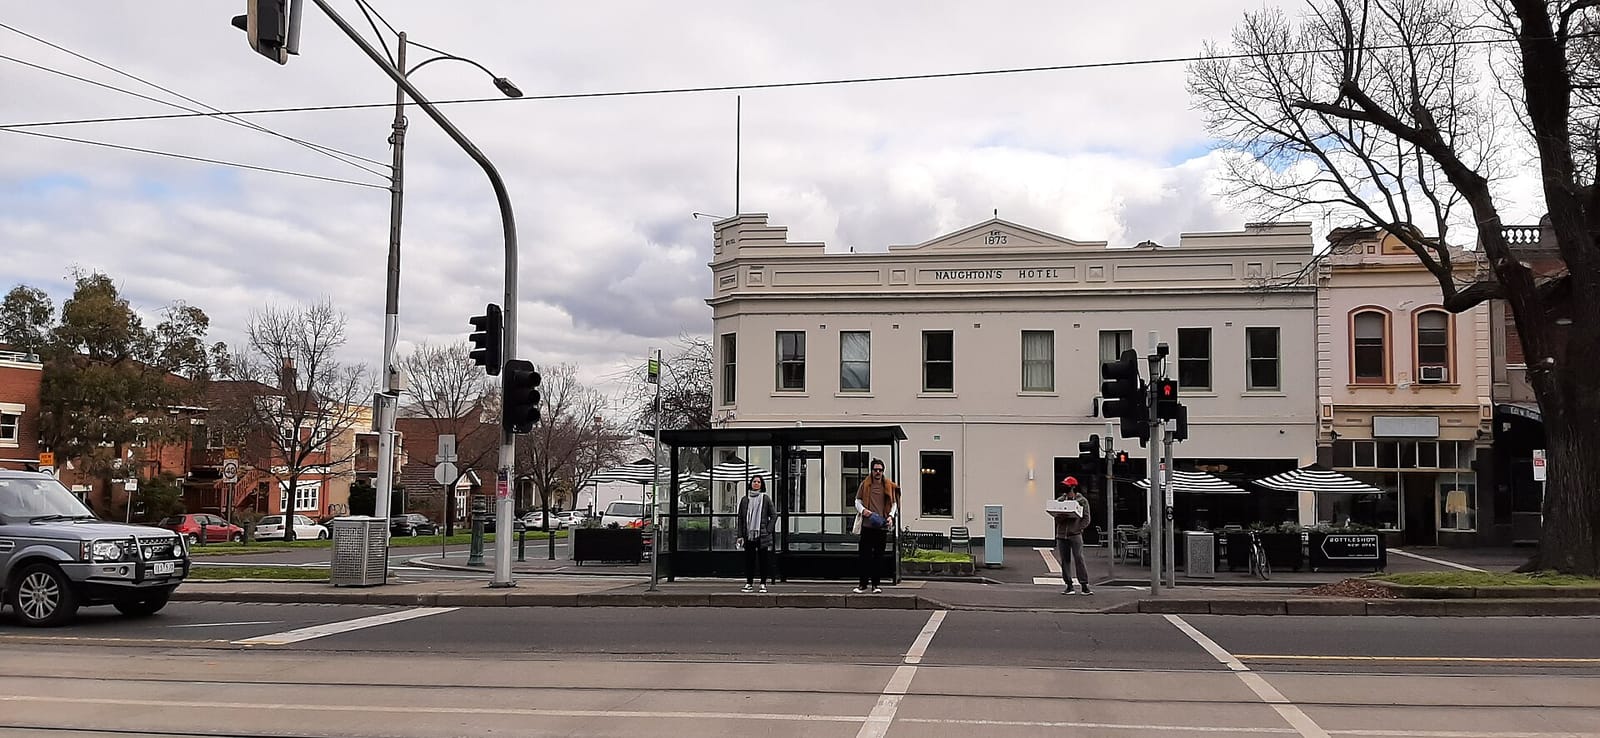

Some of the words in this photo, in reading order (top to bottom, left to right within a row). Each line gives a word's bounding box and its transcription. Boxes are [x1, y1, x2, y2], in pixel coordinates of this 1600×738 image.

[984, 236, 1007, 244] 1873
[935, 270, 1003, 279] NAUGHTON'S
[1019, 269, 1059, 278] HOTEL
